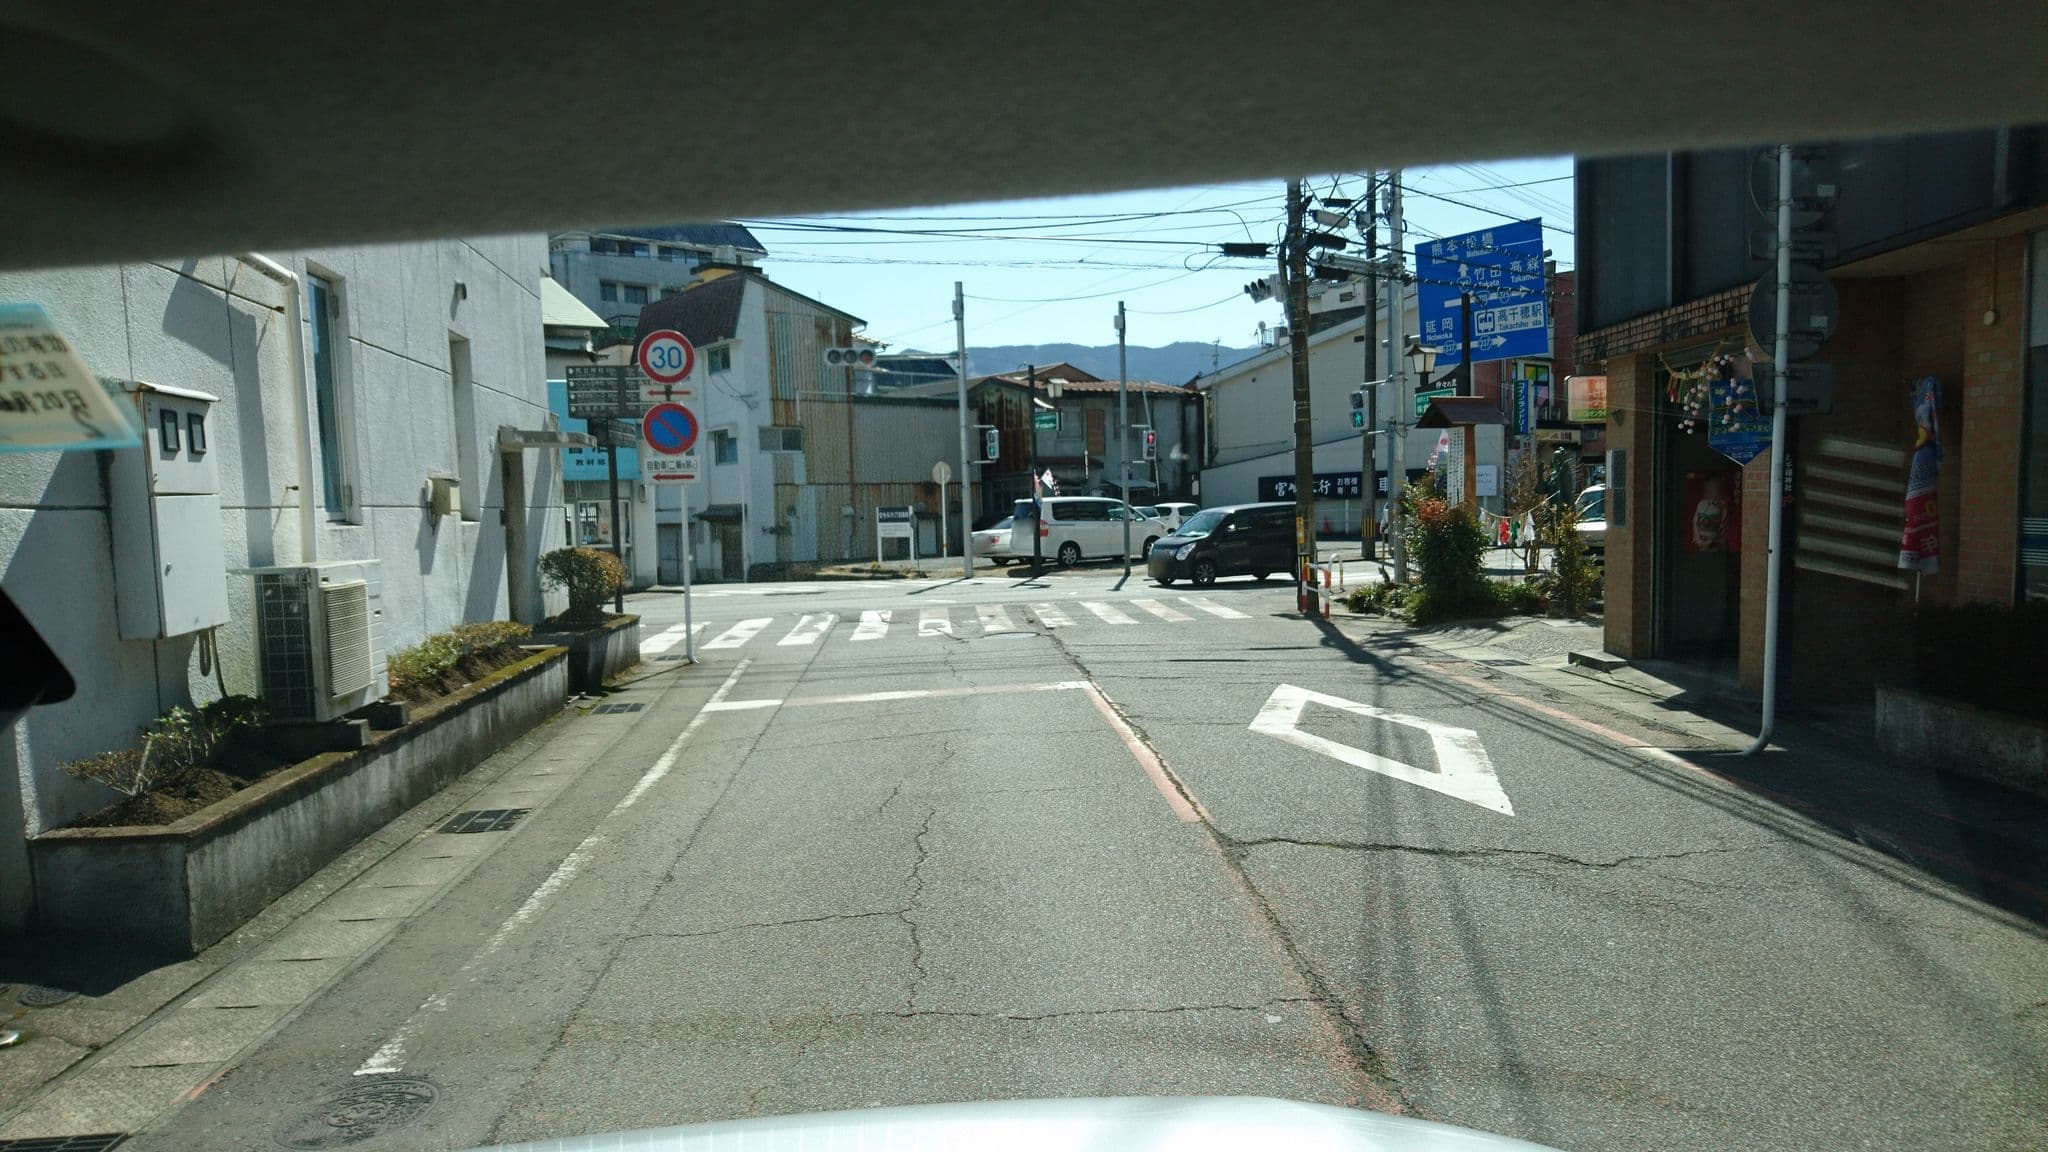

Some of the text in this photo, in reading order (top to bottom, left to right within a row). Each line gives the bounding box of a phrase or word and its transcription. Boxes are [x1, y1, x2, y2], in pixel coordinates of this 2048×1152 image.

[1497, 303, 1542, 321] 高千穂駅
[1425, 318, 1453, 334] 延岡
[1498, 320, 1529, 331] Takachiho
[652, 346, 682, 369] 30
